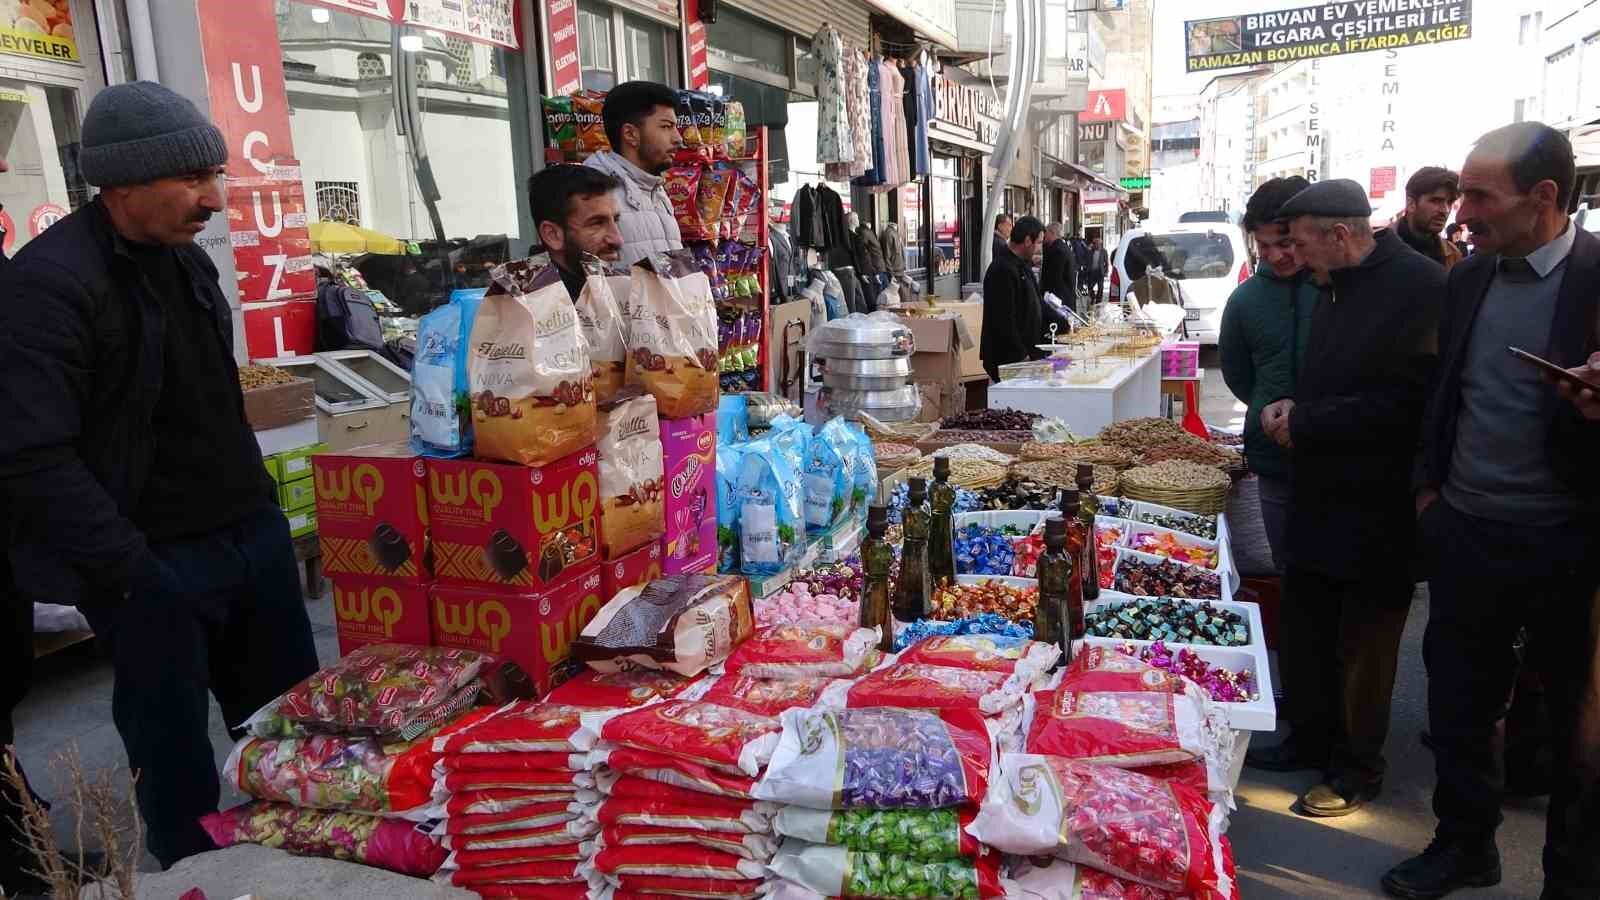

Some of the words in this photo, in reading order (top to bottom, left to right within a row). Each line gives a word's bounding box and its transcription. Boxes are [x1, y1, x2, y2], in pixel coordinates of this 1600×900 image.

[1247, 8, 1316, 30] BIRVAN
[1323, 5, 1347, 20] EV
[1255, 26, 1325, 47] IZGARA
[1331, 9, 1425, 40] ÇEŞİTLERİ
[1432, 6, 1460, 25] İLE
[0, 33, 71, 58] EYVELER
[1189, 51, 1262, 70] RAMAZAN
[1267, 42, 1340, 62] BOYUNCA
[1346, 33, 1409, 52] İFTARDA
[1414, 24, 1468, 44] AÇIĞIZ
